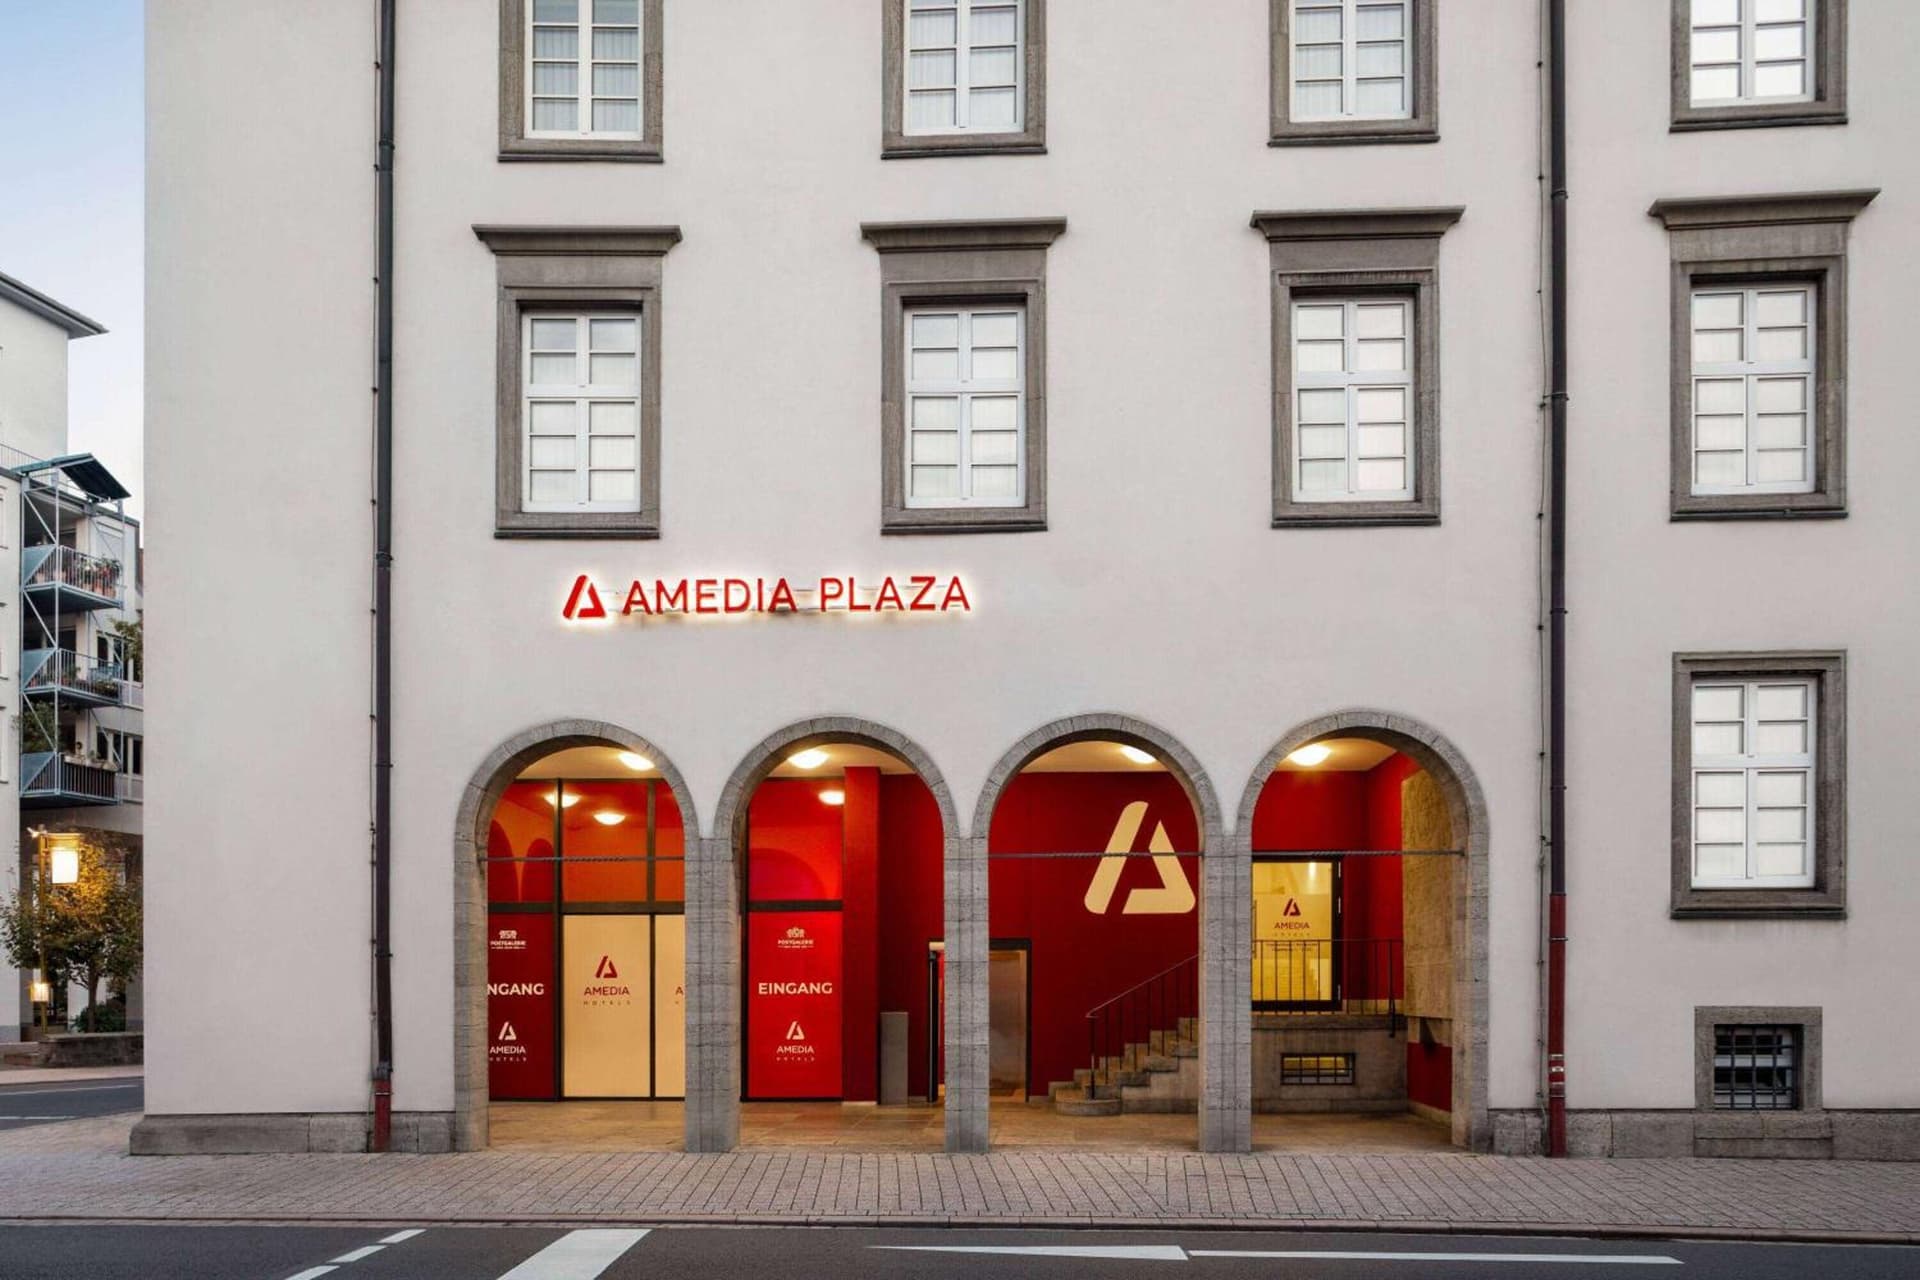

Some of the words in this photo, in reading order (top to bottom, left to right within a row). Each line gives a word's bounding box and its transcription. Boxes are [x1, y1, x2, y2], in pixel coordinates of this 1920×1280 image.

[622, 577, 798, 616] AMEDIA
[819, 575, 971, 612] PLAZA
[1274, 922, 1311, 930] AMEDIA
[583, 986, 630, 996] AMEDIA
[758, 982, 833, 995] EINGANG
[489, 1046, 526, 1055] AMEDIA
[776, 1045, 815, 1054] AMEDIA
